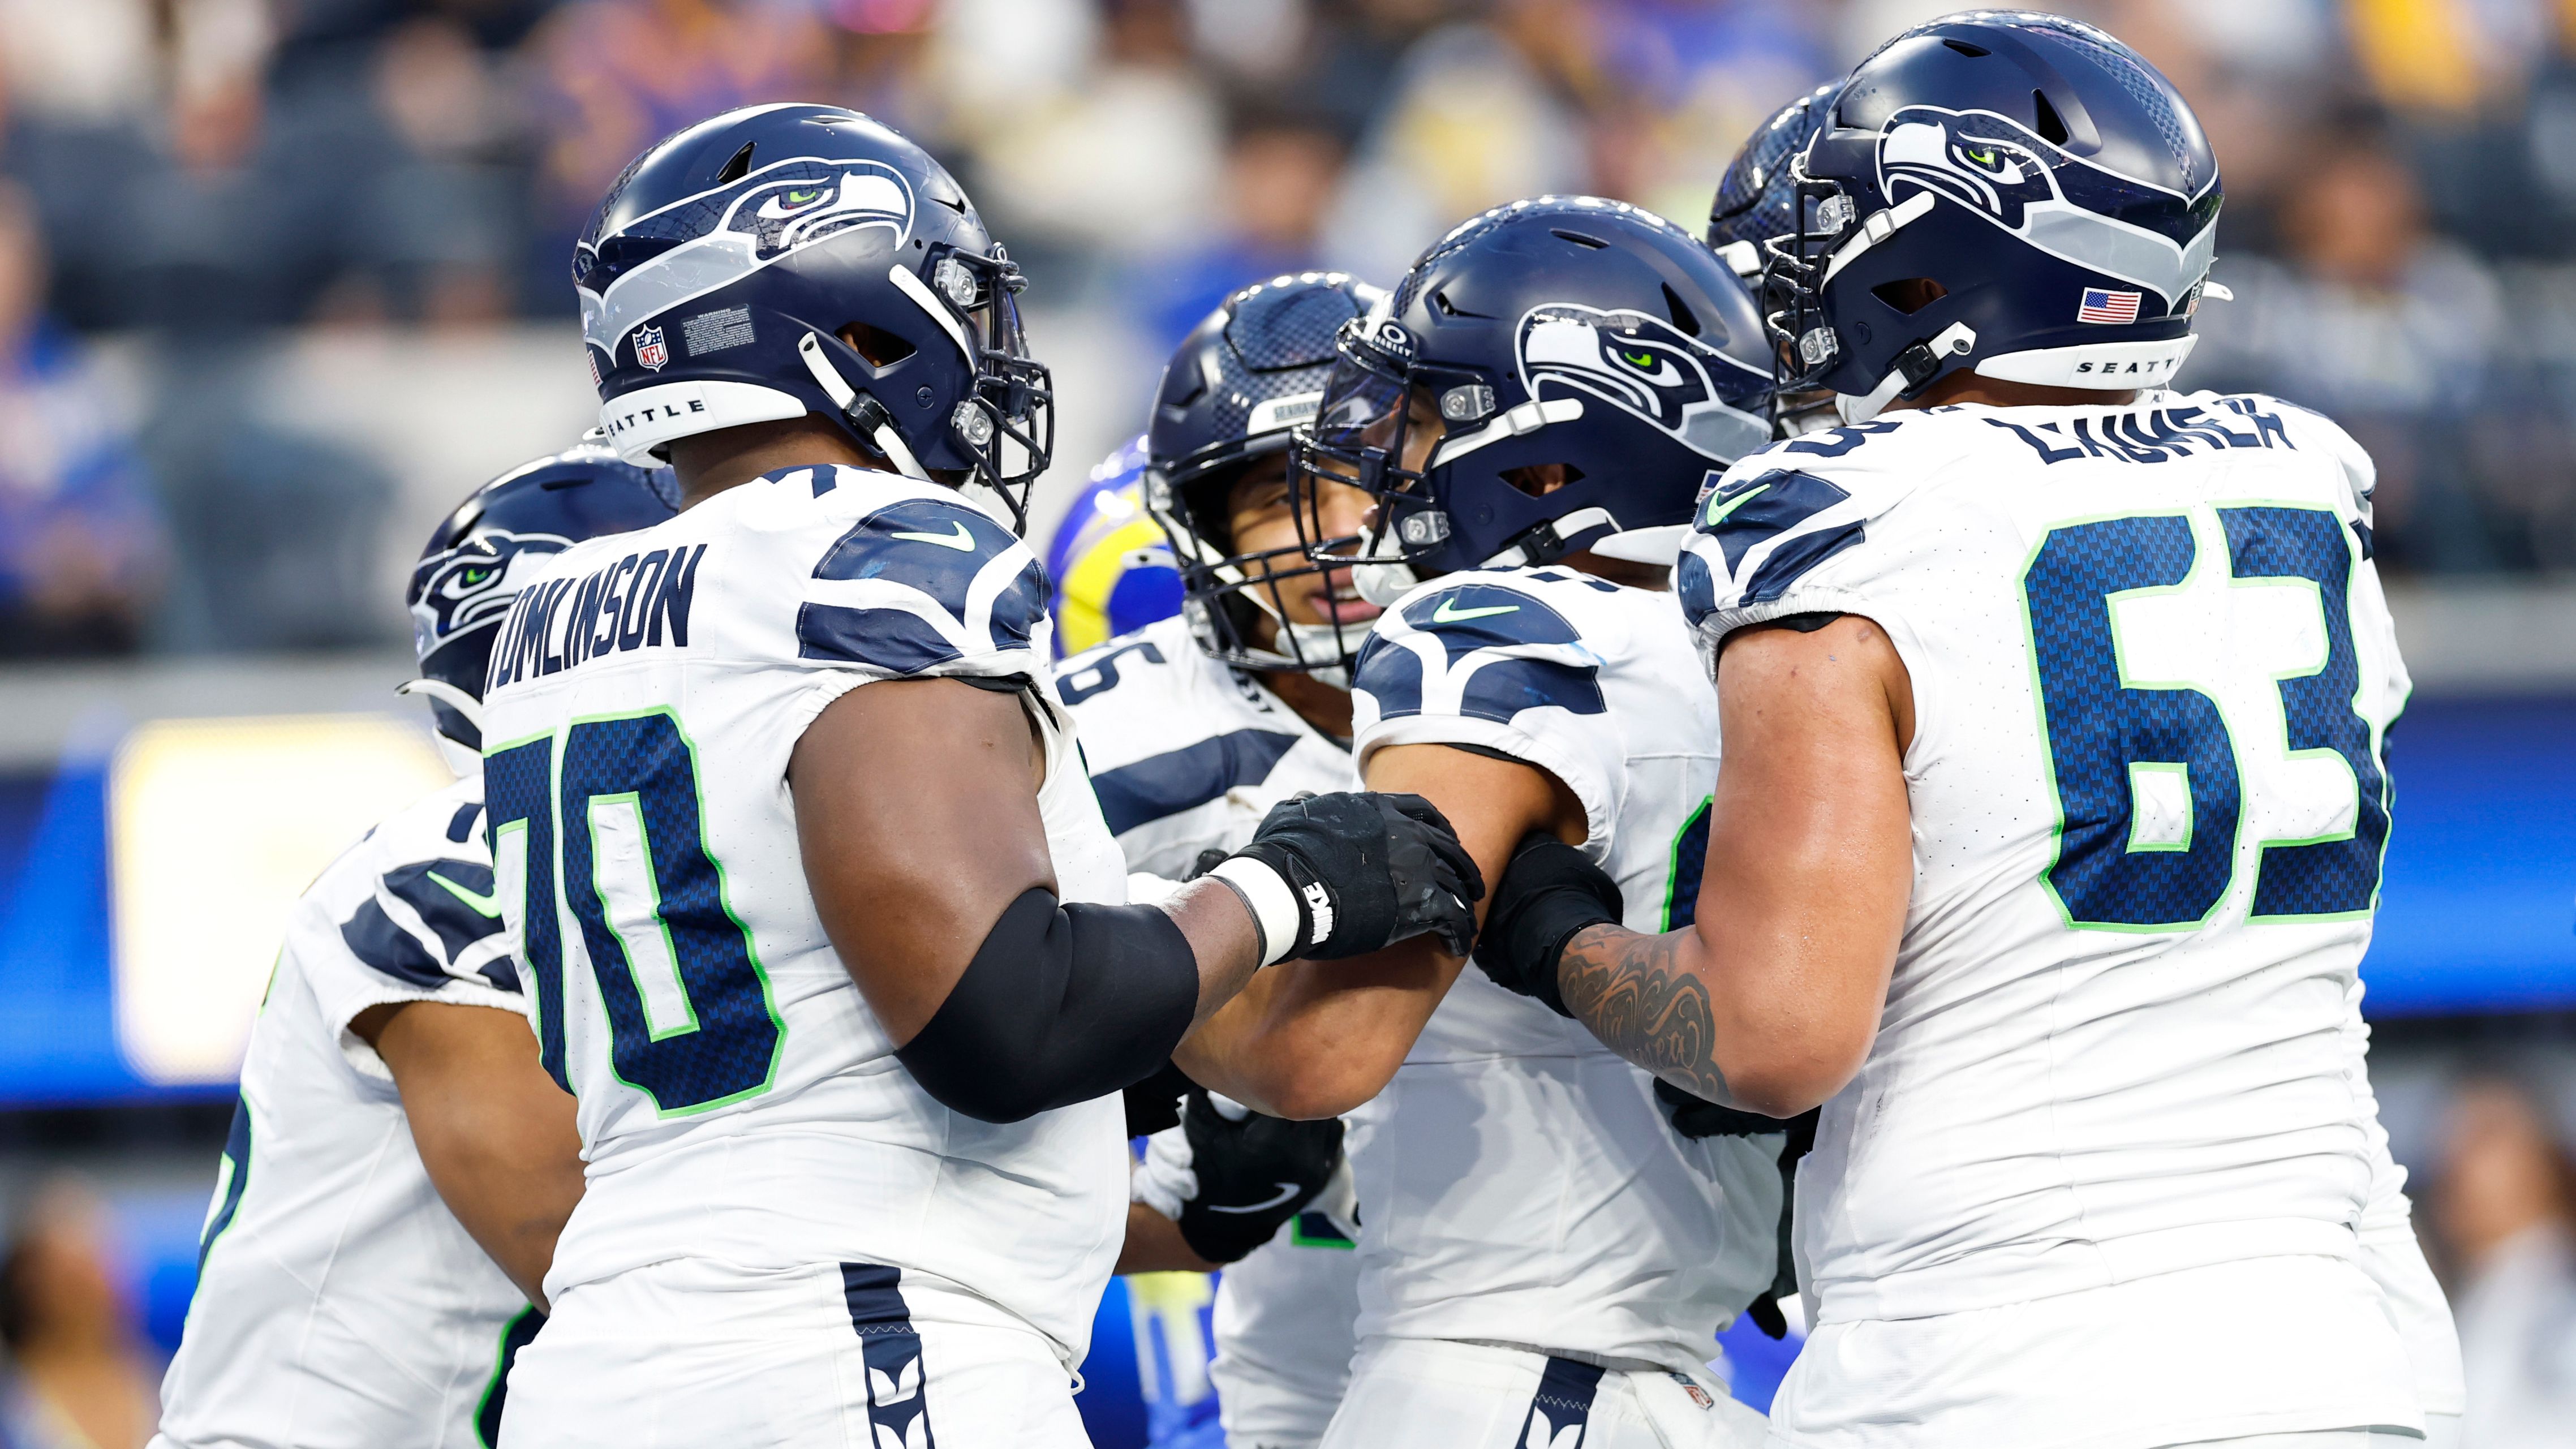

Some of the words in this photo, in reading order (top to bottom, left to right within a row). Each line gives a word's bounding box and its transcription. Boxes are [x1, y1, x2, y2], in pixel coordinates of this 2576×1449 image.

[697, 308, 731, 319] WARNING
[640, 345, 665, 364] NFL
[1374, 334, 1413, 357] OAKLEY
[608, 399, 704, 437] EATTLE
[2015, 498, 2392, 934] 63
[483, 704, 788, 1119] 70
[1302, 882, 1333, 944] NIKE
